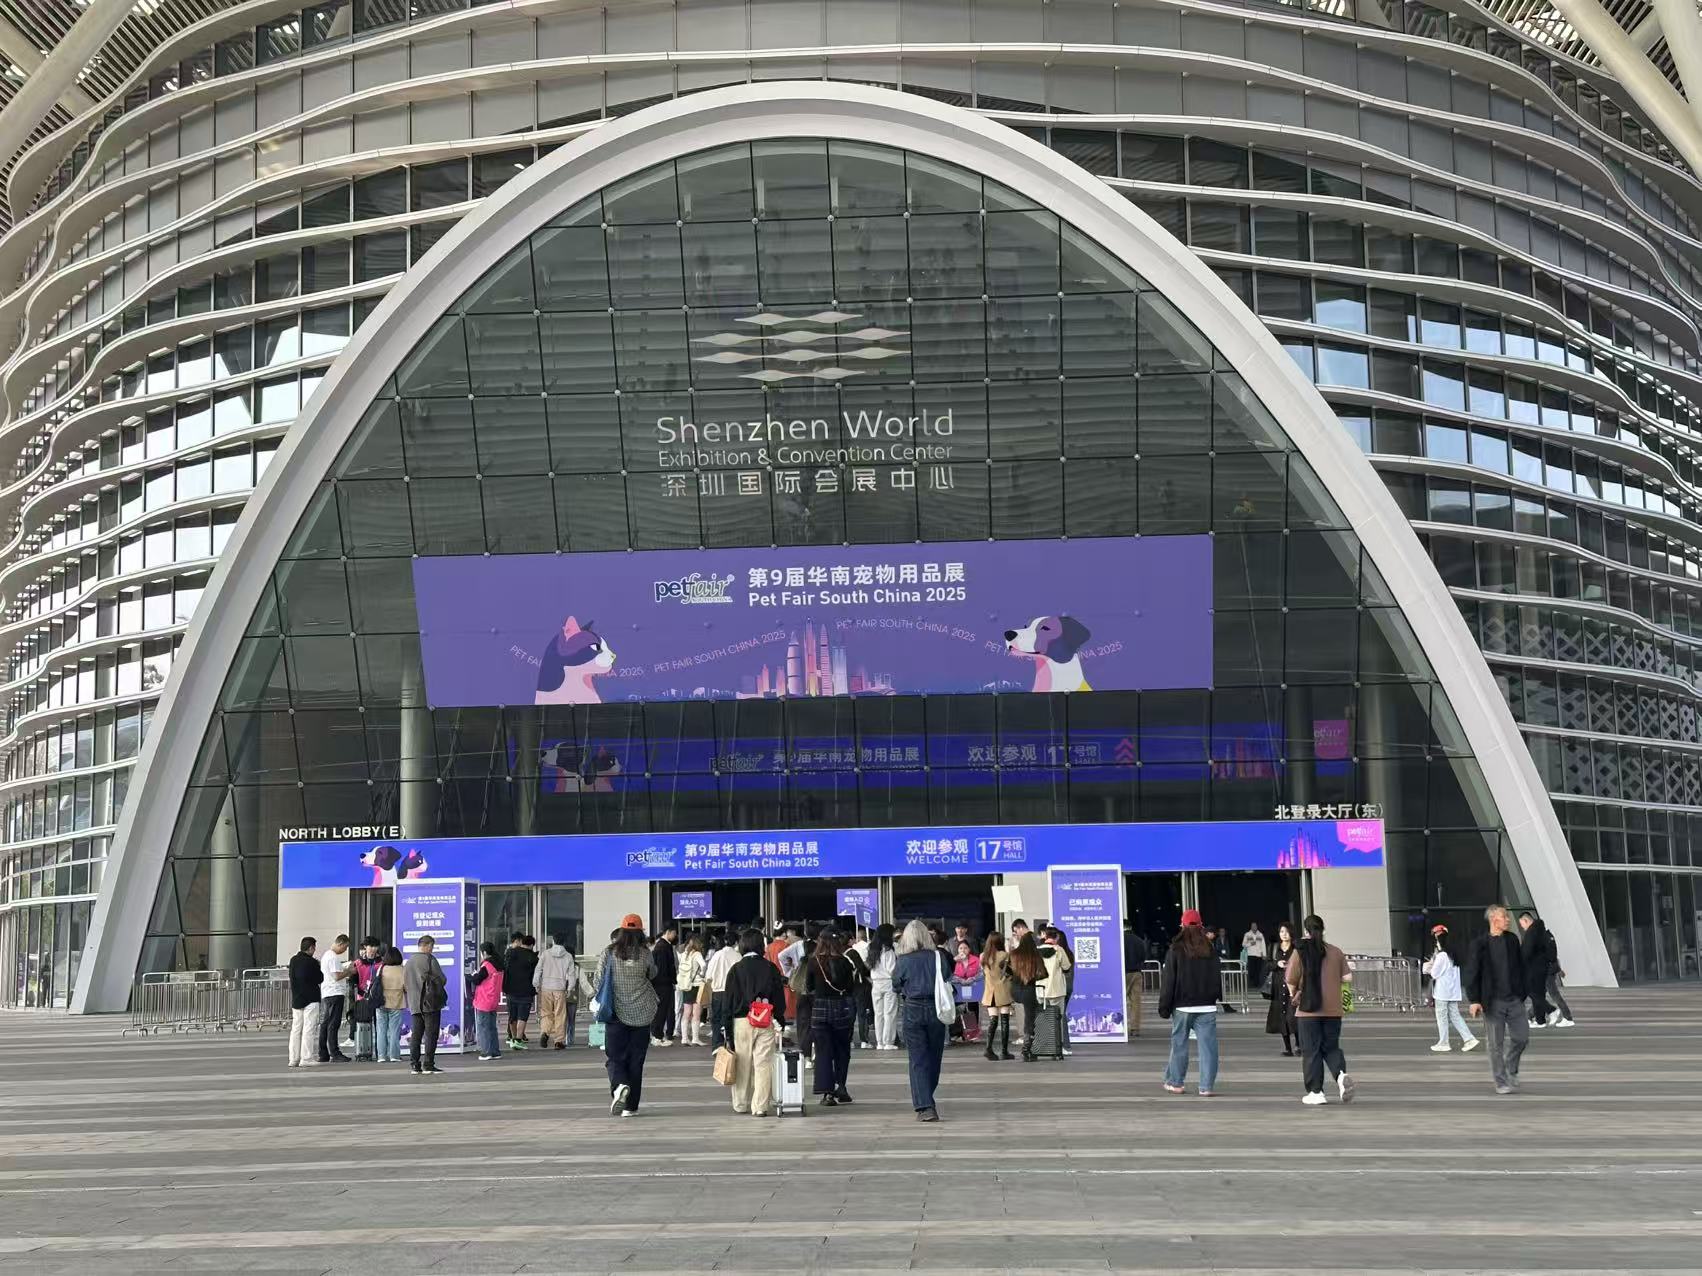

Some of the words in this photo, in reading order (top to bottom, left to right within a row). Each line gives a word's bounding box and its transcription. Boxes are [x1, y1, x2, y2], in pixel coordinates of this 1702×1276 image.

[657, 414, 829, 444] Shenzhen
[843, 408, 953, 438] World
[658, 448, 751, 468] Exhibition
[757, 447, 773, 465] &
[777, 444, 885, 465] Convention
[890, 443, 953, 462] Center
[660, 466, 955, 497] 深圳国际会展中心
[748, 562, 965, 588] 第9届华南宠物用品展
[748, 592, 777, 607] Pet
[782, 591, 815, 606] Fair
[820, 589, 868, 605] South
[873, 587, 921, 604] China
[926, 586, 966, 602] 2025
[836, 620, 852, 630] PET
[856, 619, 878, 628] FAIR
[880, 619, 913, 629] SOUTH
[916, 620, 949, 633] CHINA
[951, 628, 977, 642] 2025
[509, 644, 527, 660] PET
[527, 655, 542, 667] FAI
[653, 662, 670, 673] PET
[672, 657, 693, 671] FAIR
[694, 648, 727, 665] SOUTH
[727, 638, 760, 655] CHINA
[761, 630, 786, 644] 2025
[984, 640, 1001, 653] PET
[1098, 641, 1123, 656] 2025
[619, 667, 644, 678] 2025
[968, 744, 1037, 762] 欢迎参观
[279, 827, 328, 840] NORTH
[684, 841, 818, 857] 第9届华南宠物用品展
[906, 838, 969, 855] 欢迎参观
[977, 840, 1002, 860] 17
[1003, 840, 1023, 851] 号馆
[684, 859, 702, 870] Pet
[705, 859, 725, 869] Fair
[729, 858, 759, 869] South
[762, 857, 791, 868] China
[795, 857, 819, 867] 2025
[906, 854, 969, 865] WELCOME
[1003, 852, 1023, 860] HALL
